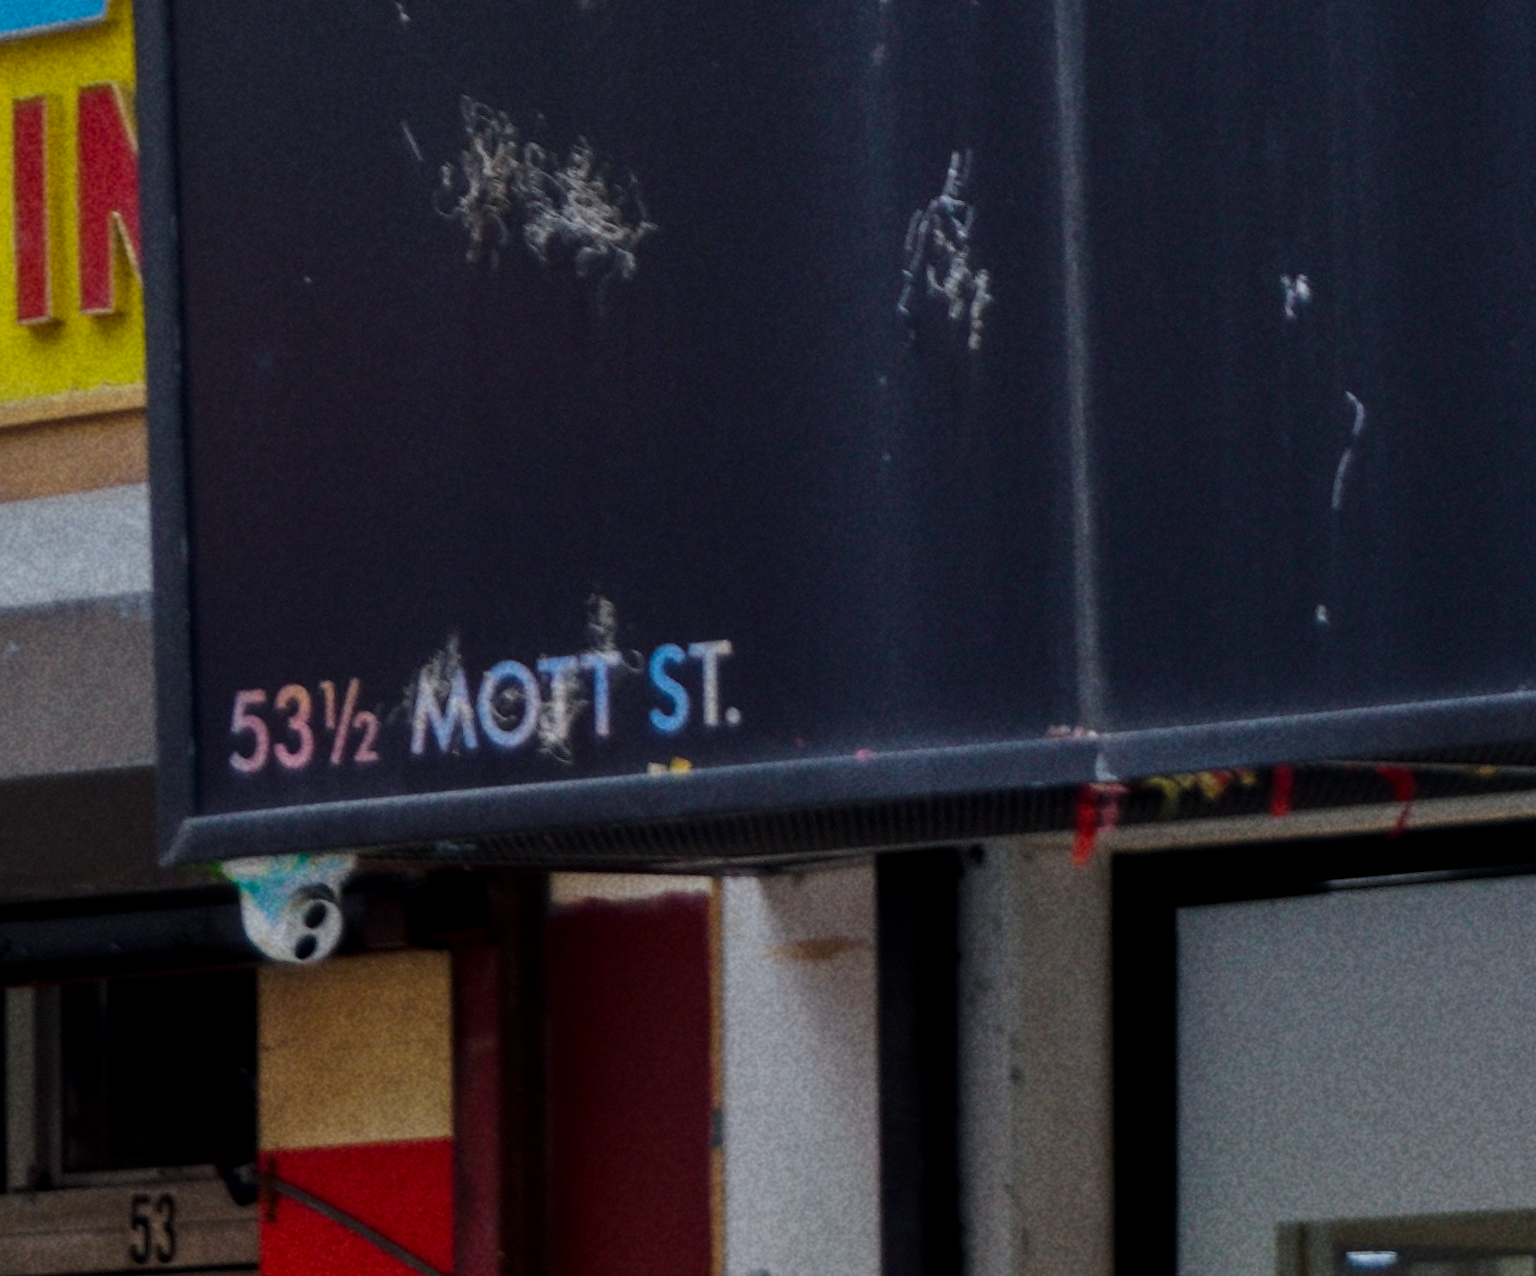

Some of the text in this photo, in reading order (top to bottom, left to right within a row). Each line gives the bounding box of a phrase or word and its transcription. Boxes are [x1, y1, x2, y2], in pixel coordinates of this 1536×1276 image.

[410, 648, 623, 756] MOTT
[647, 639, 741, 734] ST.
[129, 1193, 178, 1264] 53
